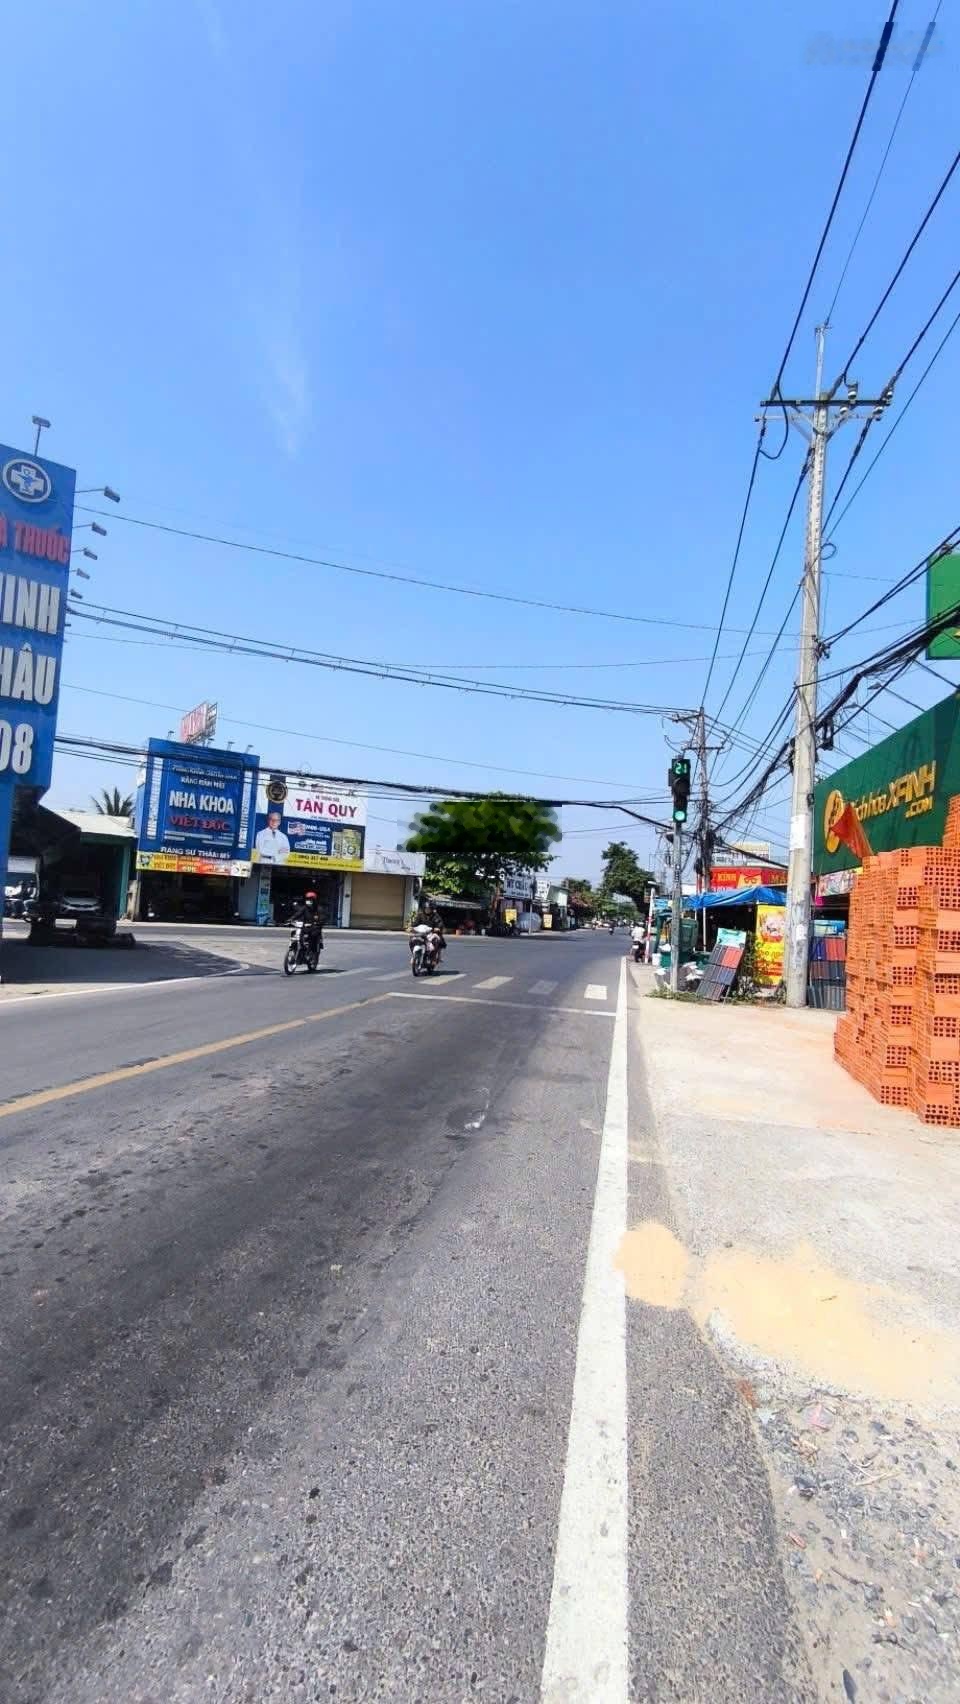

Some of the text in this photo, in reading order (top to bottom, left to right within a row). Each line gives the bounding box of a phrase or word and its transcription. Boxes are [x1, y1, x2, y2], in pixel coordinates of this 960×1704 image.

[675, 762, 688, 775] 21
[886, 760, 936, 810] XANH
[169, 790, 234, 815] NHA KHOA
[296, 798, 323, 814] TÂN
